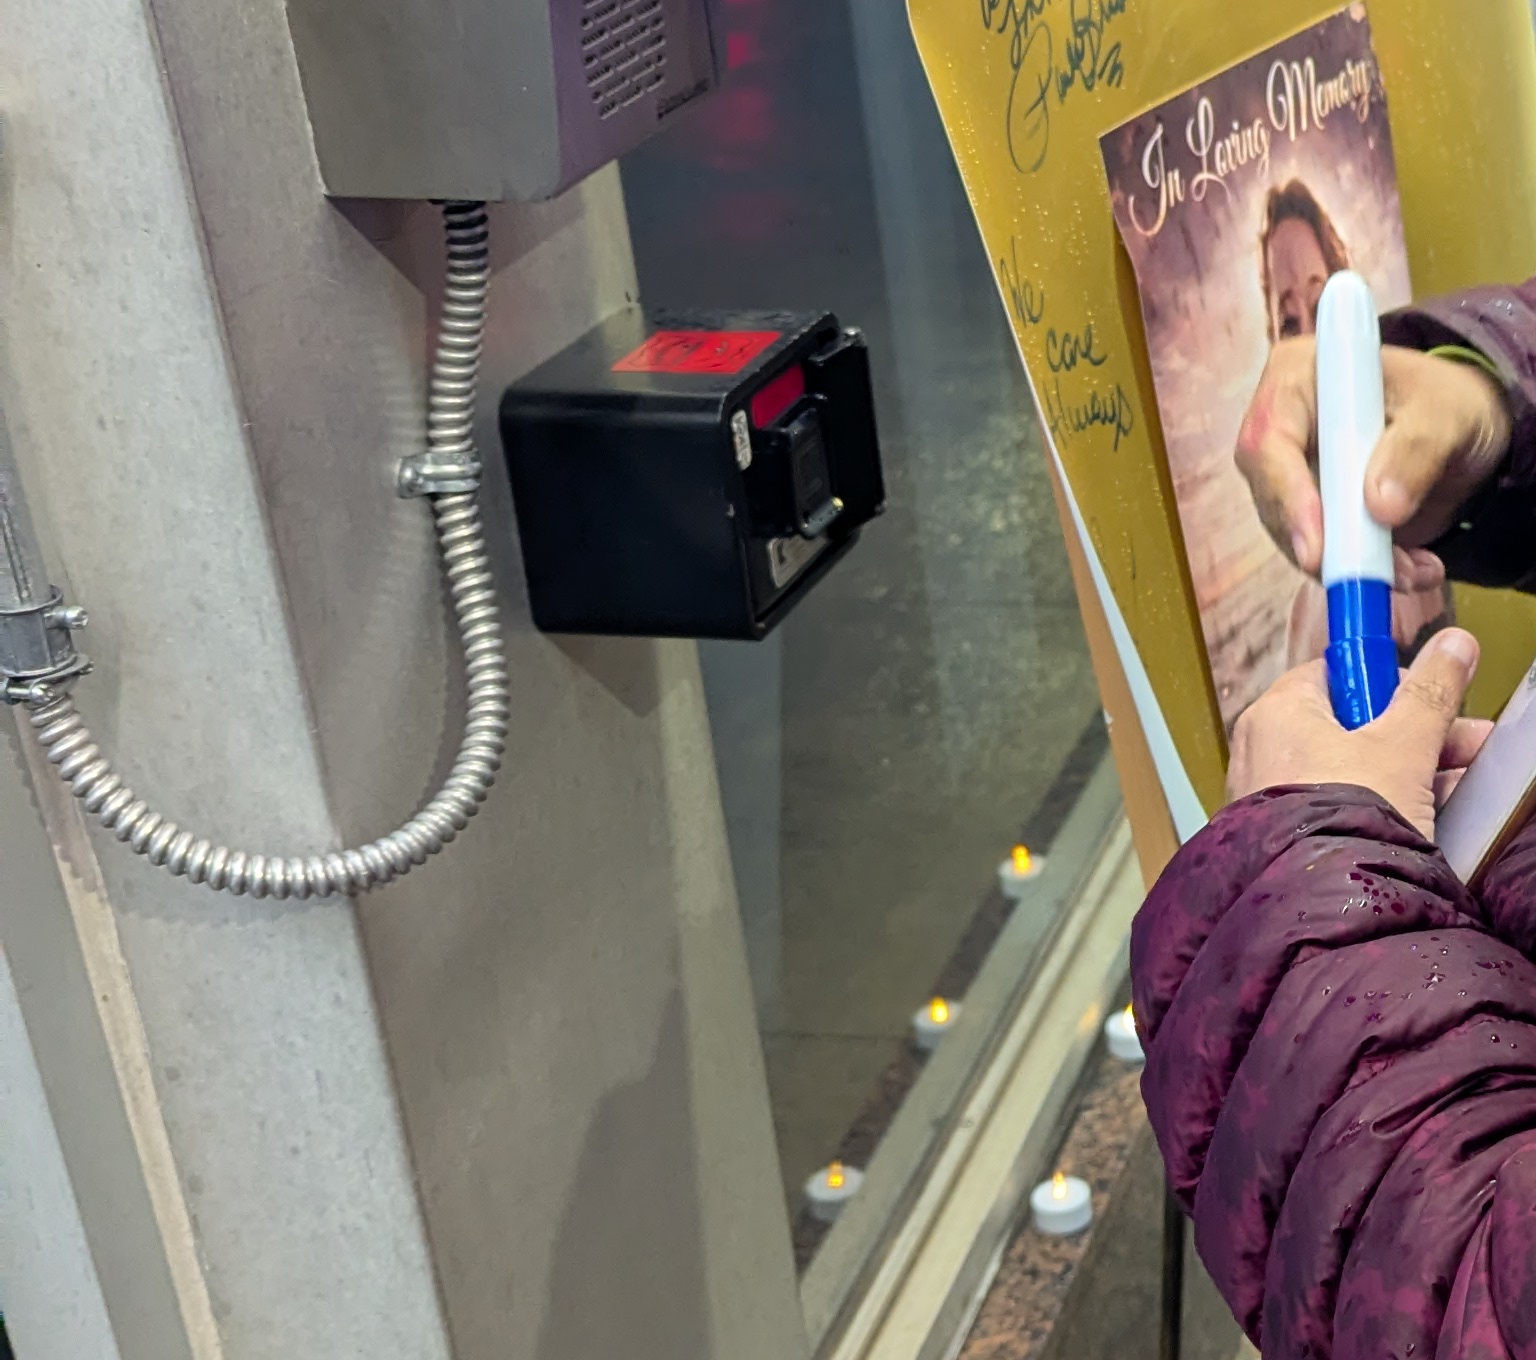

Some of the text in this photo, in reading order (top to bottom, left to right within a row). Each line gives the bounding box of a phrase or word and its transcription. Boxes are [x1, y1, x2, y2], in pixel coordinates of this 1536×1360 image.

[1129, 56, 1371, 237] In Loving Memory
[1046, 323, 1108, 373] care
